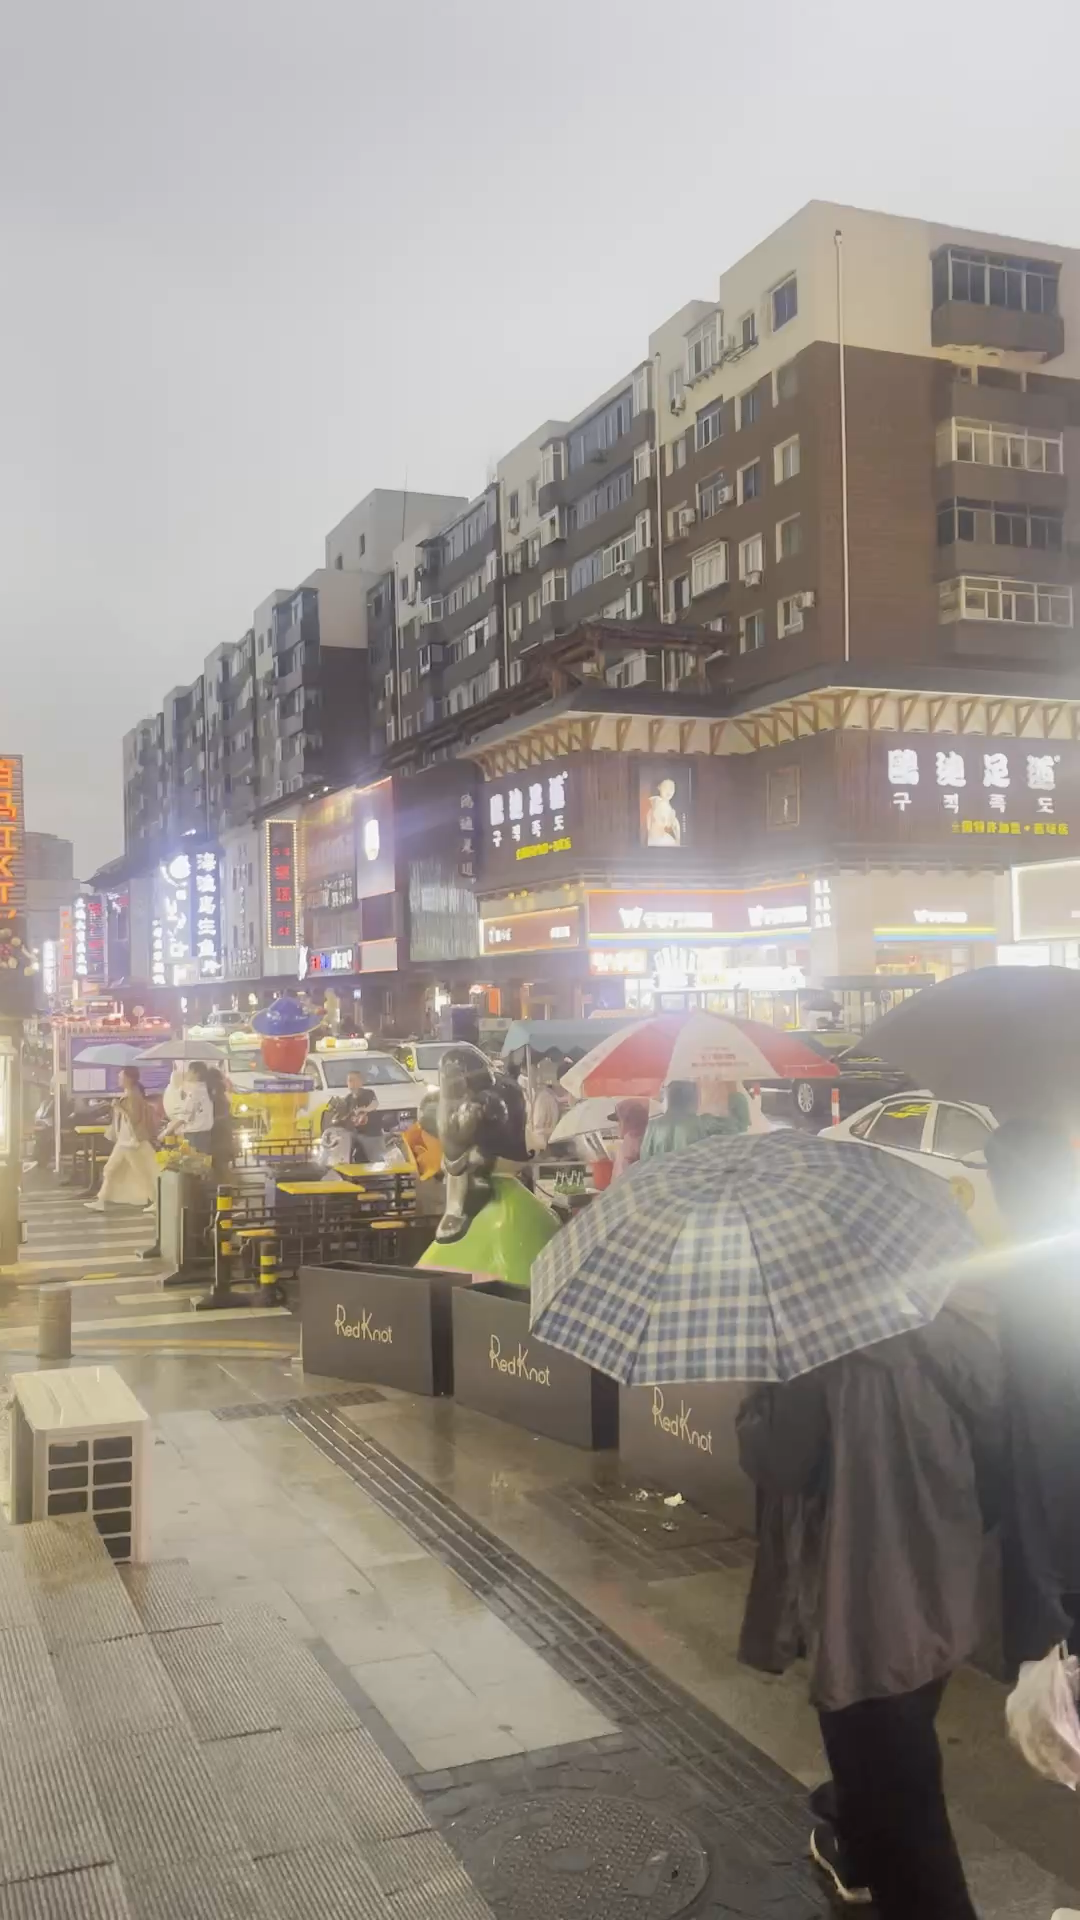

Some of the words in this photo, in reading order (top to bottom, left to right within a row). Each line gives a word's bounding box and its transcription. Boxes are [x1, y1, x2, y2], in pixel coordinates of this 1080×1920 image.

[335, 1303, 393, 1344] RedKnot
[489, 1333, 551, 1387] RedKnot
[652, 1385, 713, 1456] RedKnot
